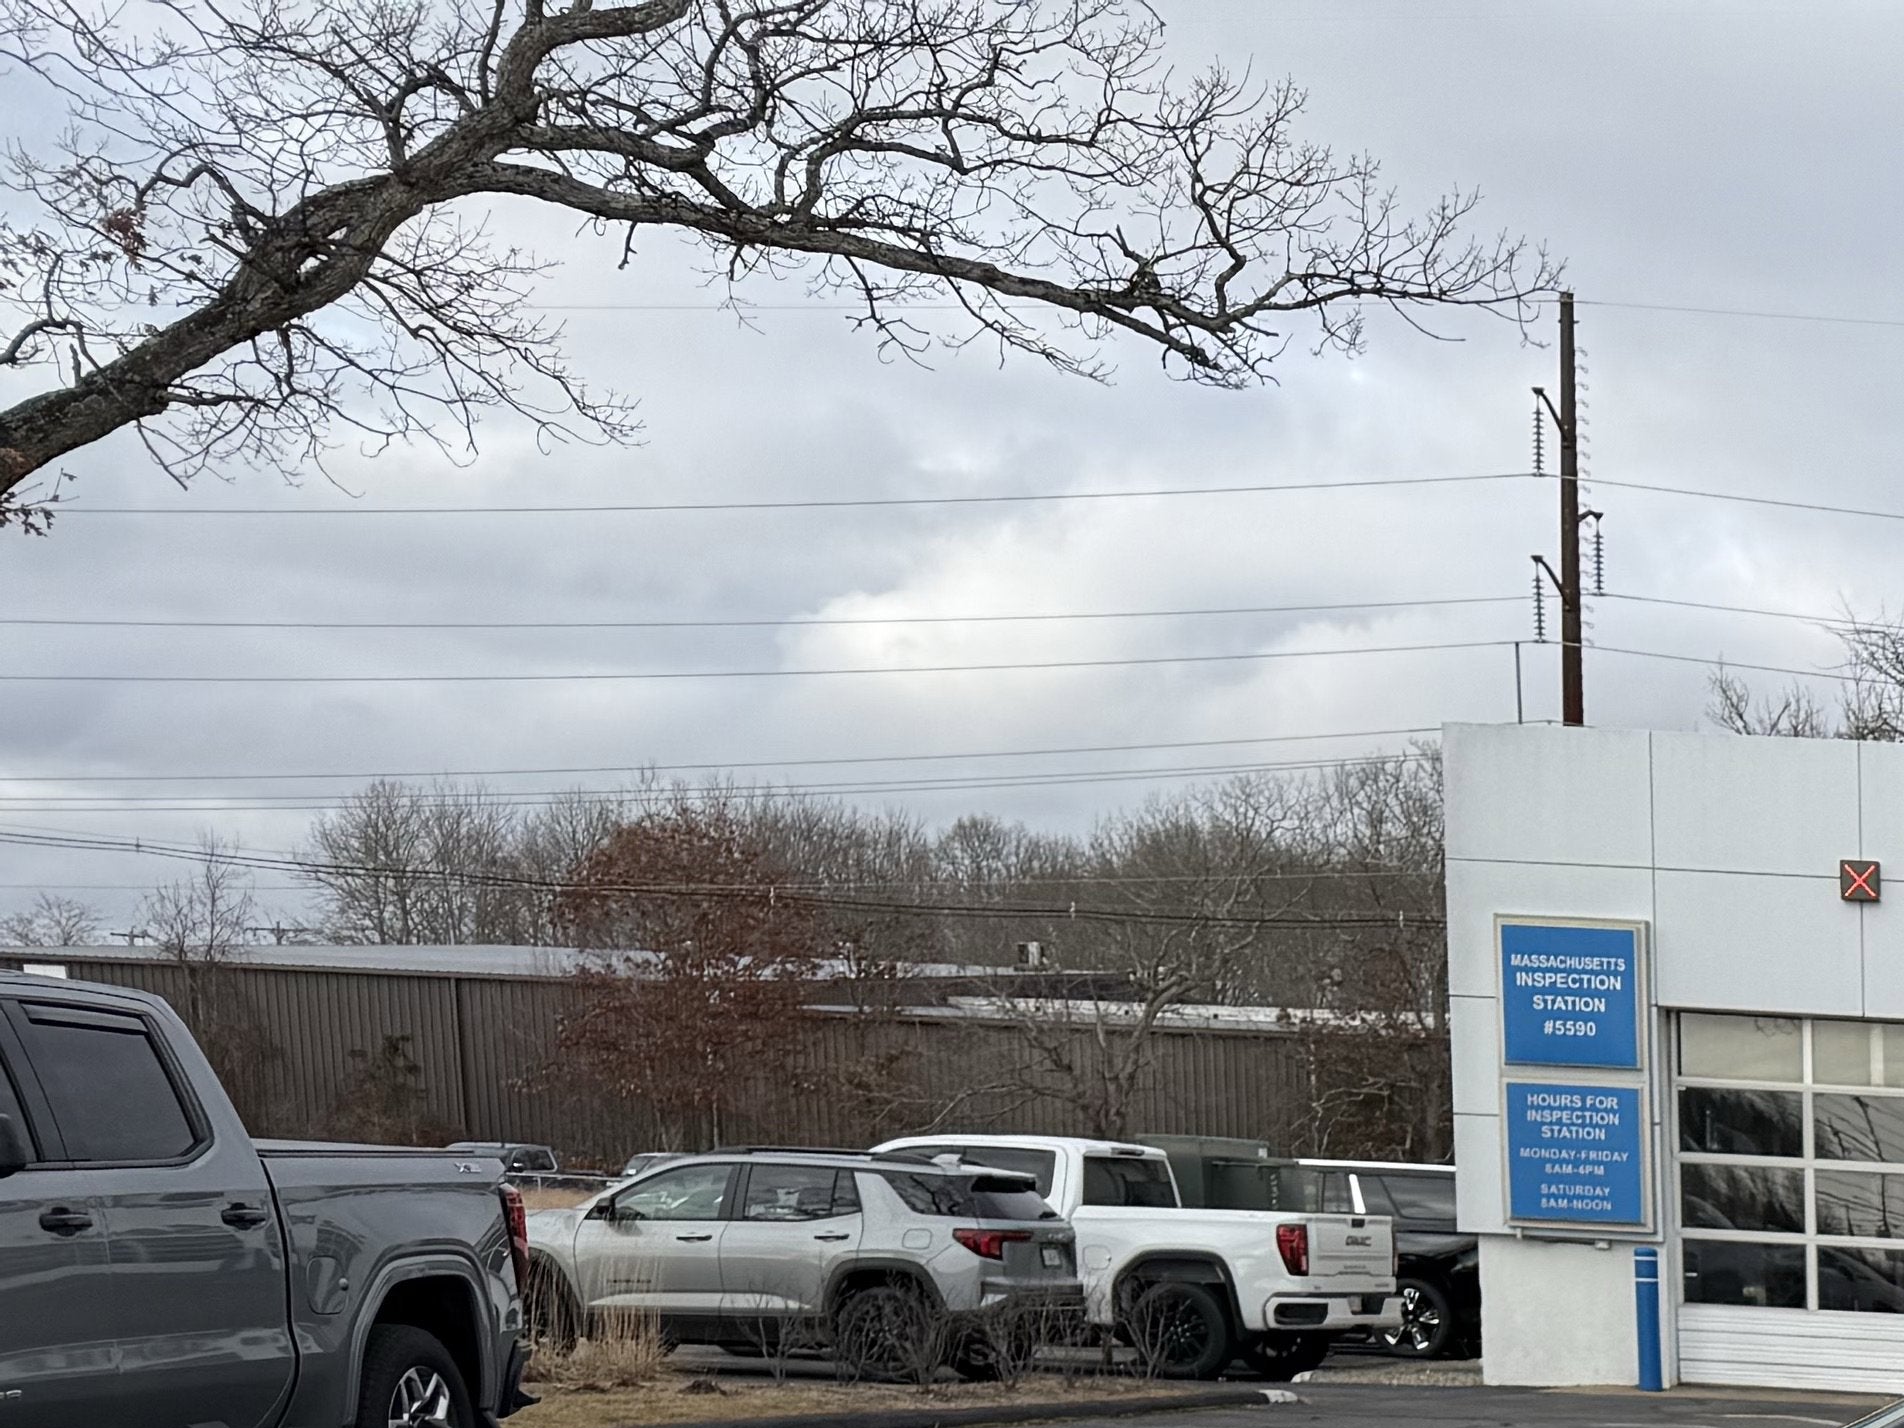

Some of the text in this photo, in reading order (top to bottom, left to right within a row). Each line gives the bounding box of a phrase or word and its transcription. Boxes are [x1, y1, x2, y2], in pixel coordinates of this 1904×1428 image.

[1510, 954, 1626, 971] MASSACHUSETTS
[1516, 972, 1621, 990] INSPECTION
[1532, 995, 1606, 1012] STATION
[1543, 1020, 1596, 1036] #5590
[1526, 1093, 1618, 1109] HOURS FOR
[1526, 1110, 1620, 1125] INSPECTION
[1541, 1125, 1606, 1140] STATION
[1519, 1147, 1629, 1162] MONDAY-FRIDAY
[1540, 1184, 1610, 1197] SATURDAY
